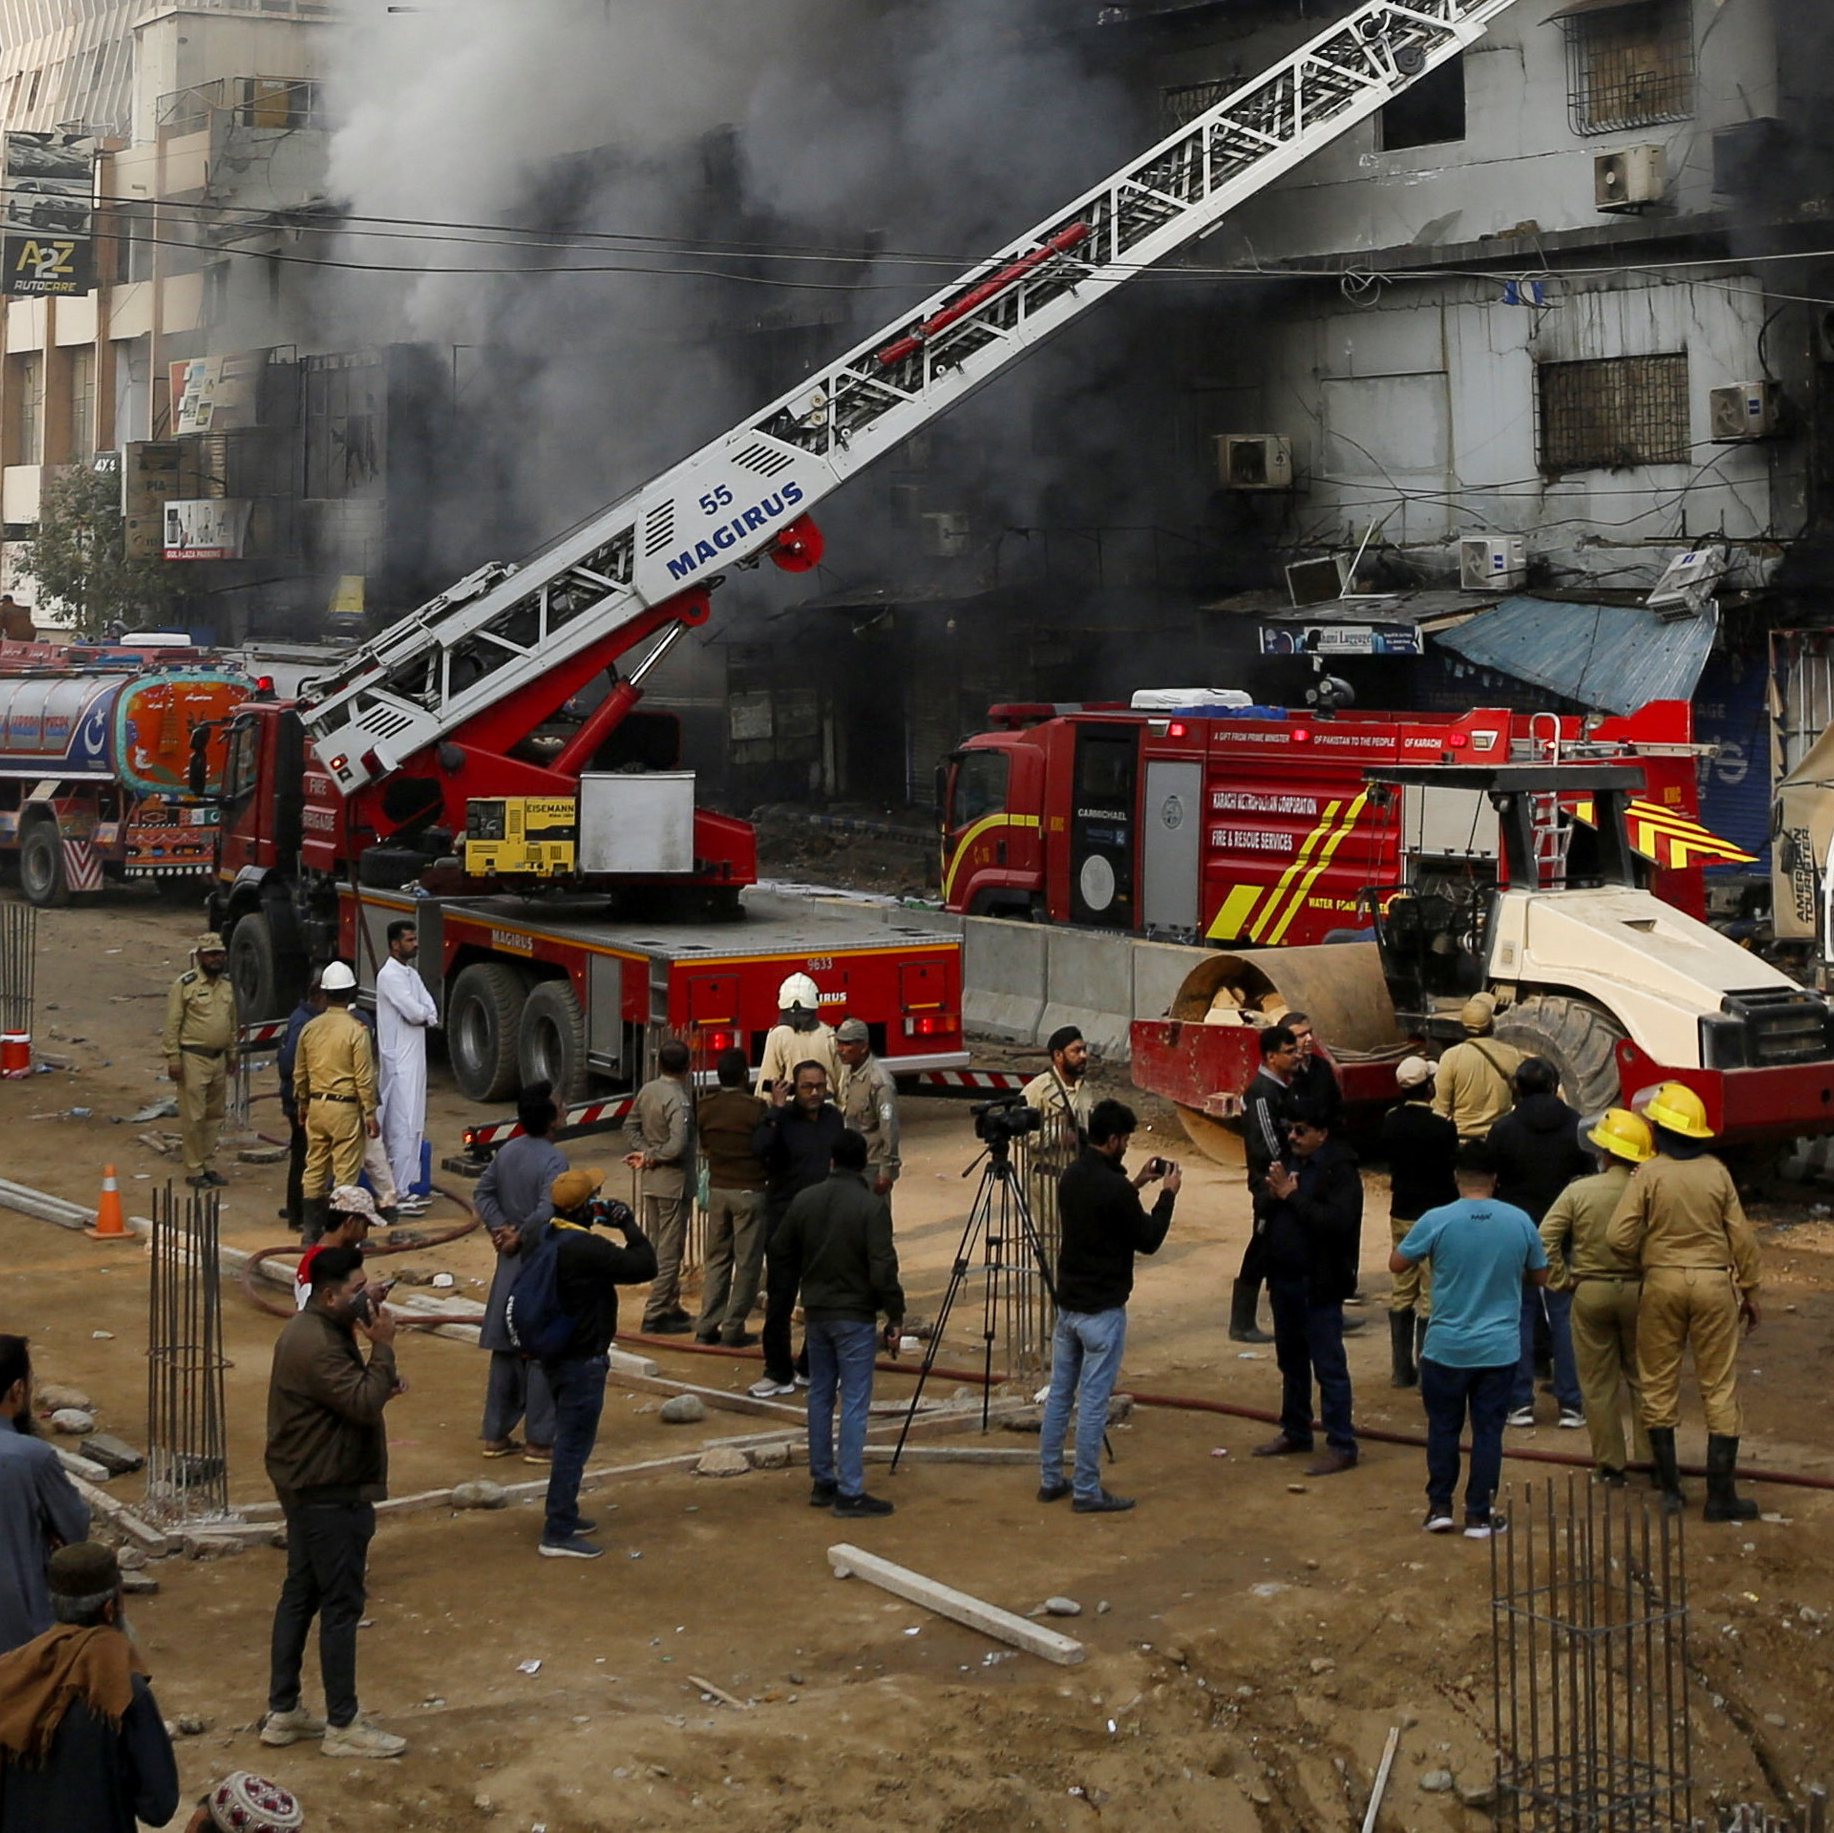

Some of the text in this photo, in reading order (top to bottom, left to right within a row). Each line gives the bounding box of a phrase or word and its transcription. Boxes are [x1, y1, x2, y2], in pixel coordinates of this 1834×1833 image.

[16, 240, 75, 279] A2Z
[14, 279, 77, 292] AUTOCARE
[699, 484, 734, 516] 55
[665, 480, 804, 581] MAGIRUS
[1322, 735, 1350, 746] PAKISTAN
[1351, 736, 1360, 746] TO
[1359, 736, 1371, 746] THE
[1371, 737, 1396, 747] PEOPLE
[1404, 738, 1414, 748] OF
[1413, 738, 1443, 749] KARACHI
[309, 777, 327, 796] FIRE
[526, 804, 575, 814] EISEMANN
[1077, 807, 1128, 822] CARMICHAEL
[1211, 829, 1227, 847] FIRE
[1233, 830, 1260, 849] RESCUE
[1260, 832, 1293, 852] SERVICES
[1308, 896, 1334, 910] WATER
[1336, 899, 1357, 912] FOAM
[491, 929, 534, 951] MAGIRUS
[807, 956, 833, 971] 9633
[818, 991, 848, 1003] IRUS
